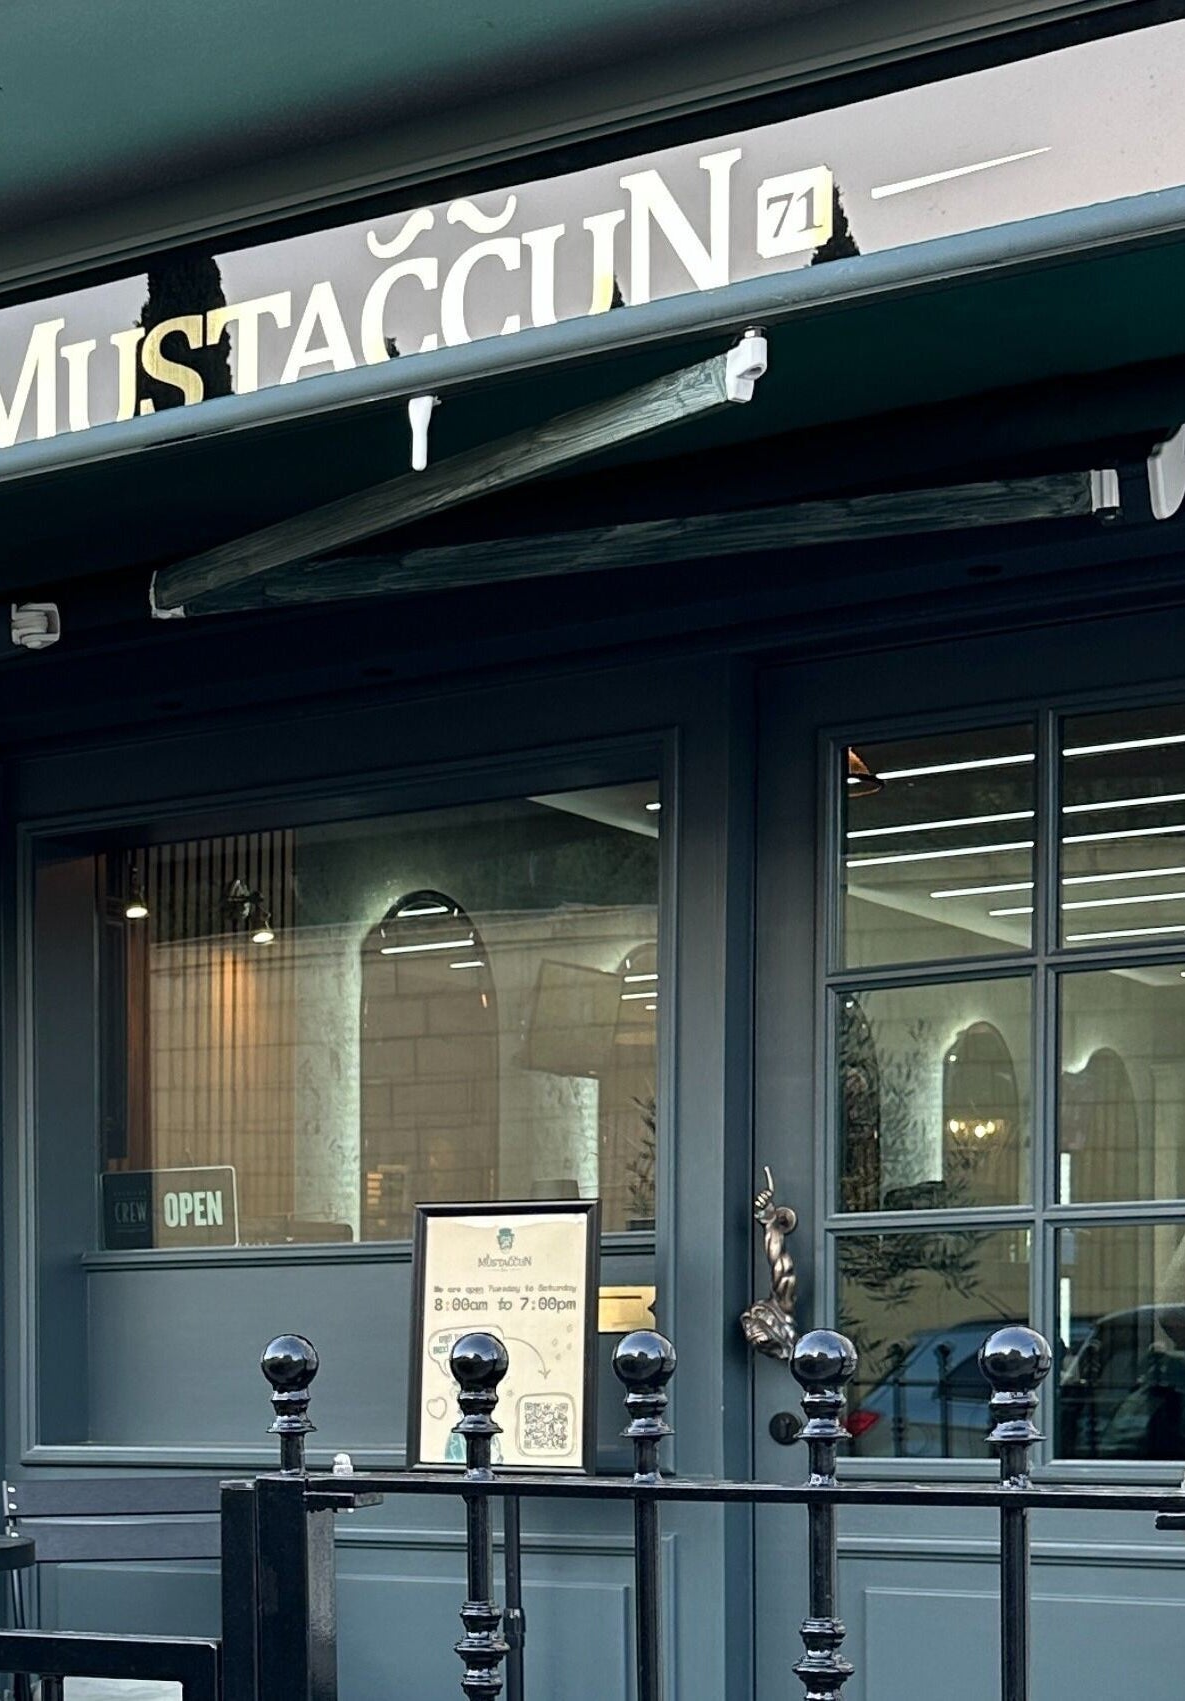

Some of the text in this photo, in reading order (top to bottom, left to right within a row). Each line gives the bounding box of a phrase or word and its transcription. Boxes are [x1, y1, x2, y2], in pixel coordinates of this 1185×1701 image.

[765, 184, 825, 240] 71
[114, 1201, 148, 1224] CREW
[163, 1190, 224, 1228] OPEN
[433, 1285, 444, 1293] We
[465, 1286, 484, 1295] open
[488, 1284, 521, 1293] Tuesday
[525, 1284, 534, 1292] to
[537, 1284, 577, 1293] Saturday
[433, 1296, 577, 1313] 8:00am to 7:00pm
